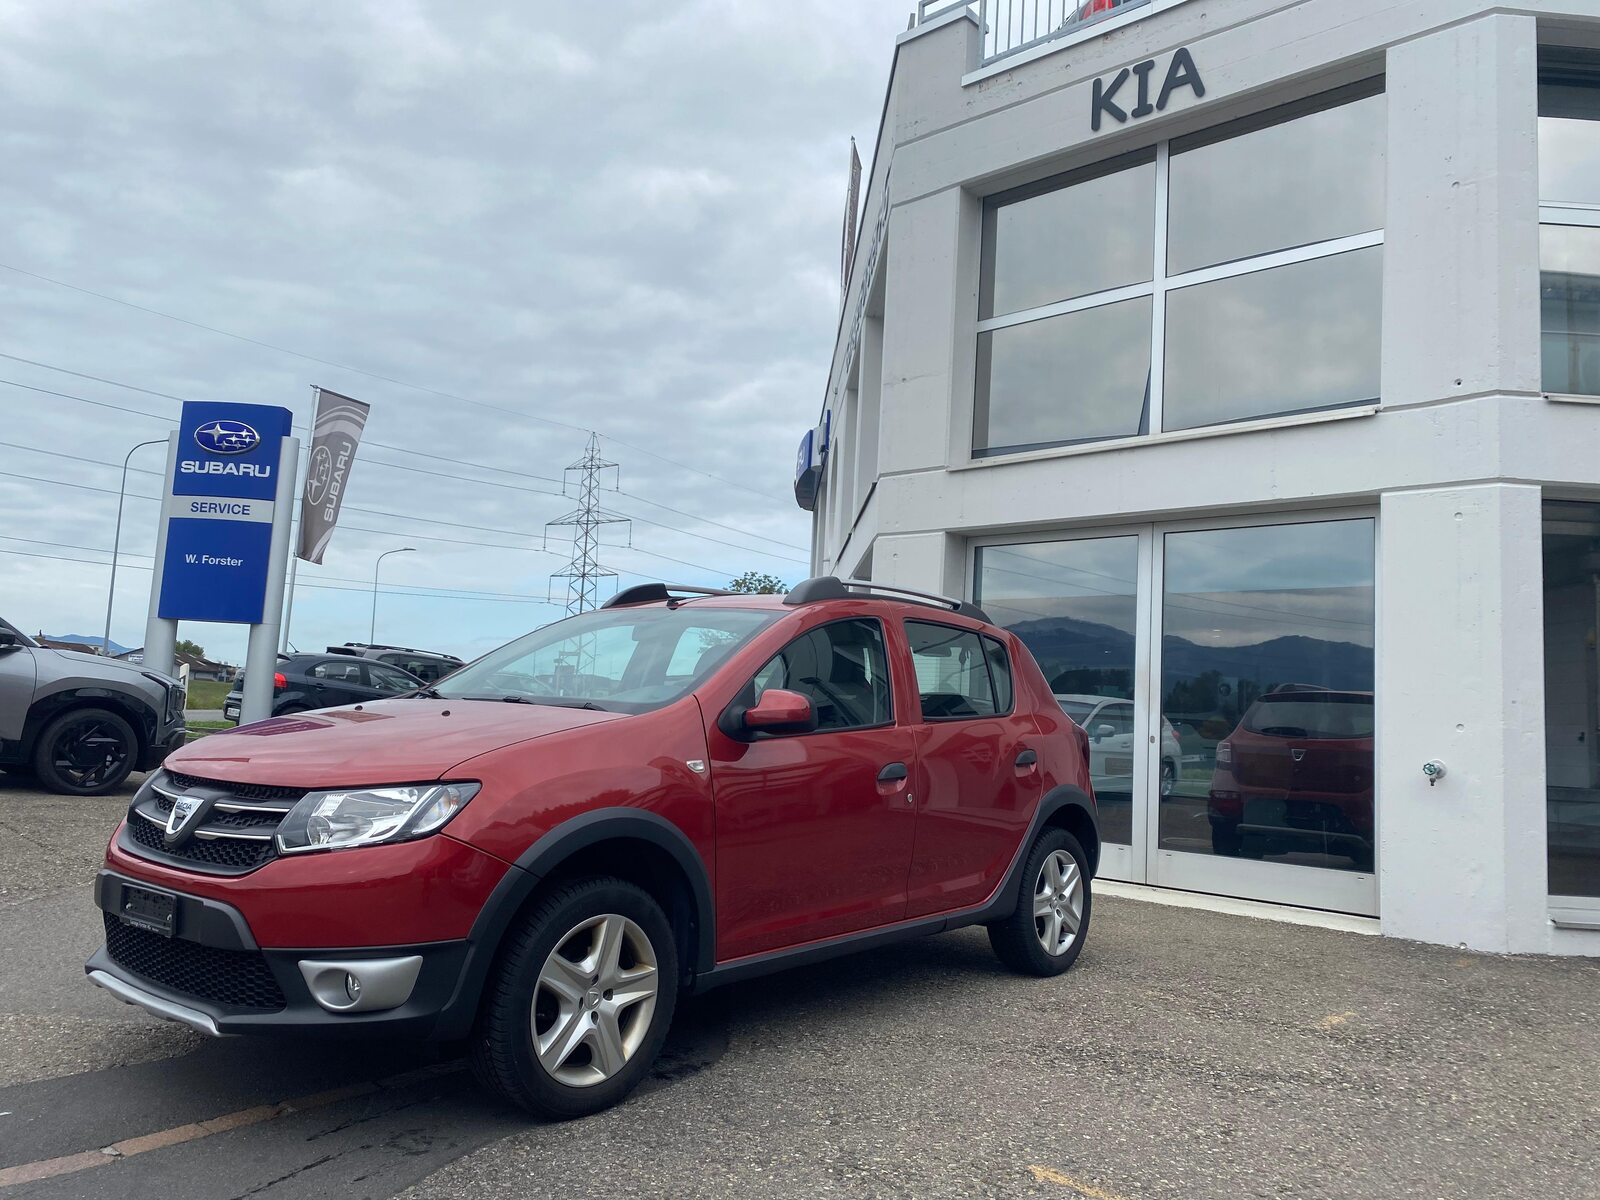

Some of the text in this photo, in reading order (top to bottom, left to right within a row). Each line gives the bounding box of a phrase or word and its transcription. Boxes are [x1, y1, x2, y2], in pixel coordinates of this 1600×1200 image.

[1091, 47, 1205, 132] KIA
[180, 460, 270, 477] SUBARU
[323, 441, 352, 522] SUBARU
[190, 501, 251, 516] SERVICE
[185, 553, 244, 567] W. Forster
